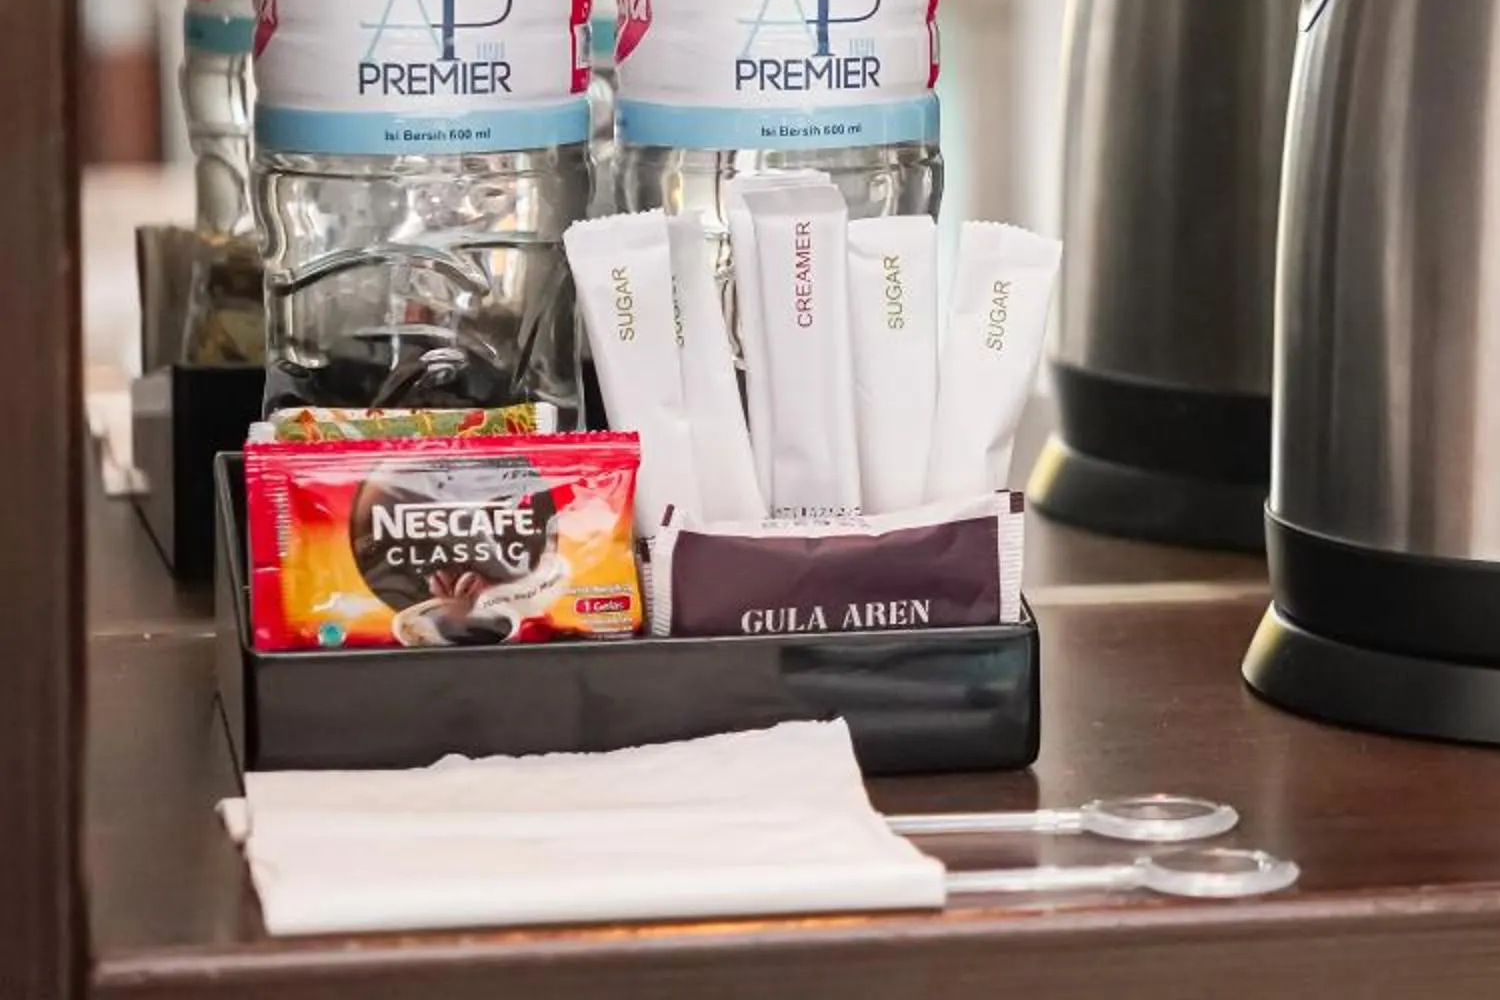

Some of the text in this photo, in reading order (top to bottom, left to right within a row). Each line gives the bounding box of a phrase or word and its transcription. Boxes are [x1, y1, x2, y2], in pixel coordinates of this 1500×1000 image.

[359, 61, 513, 95] PREMIER
[736, 56, 881, 90] PREMIER
[475, 127, 491, 139] ml
[796, 219, 812, 329] CREAMER
[884, 253, 905, 330] SUGAR
[611, 265, 635, 342] SUGAR
[986, 279, 1012, 351] SUGAR
[386, 541, 526, 565] CLASSIC
[740, 598, 932, 635] GULA AREN
